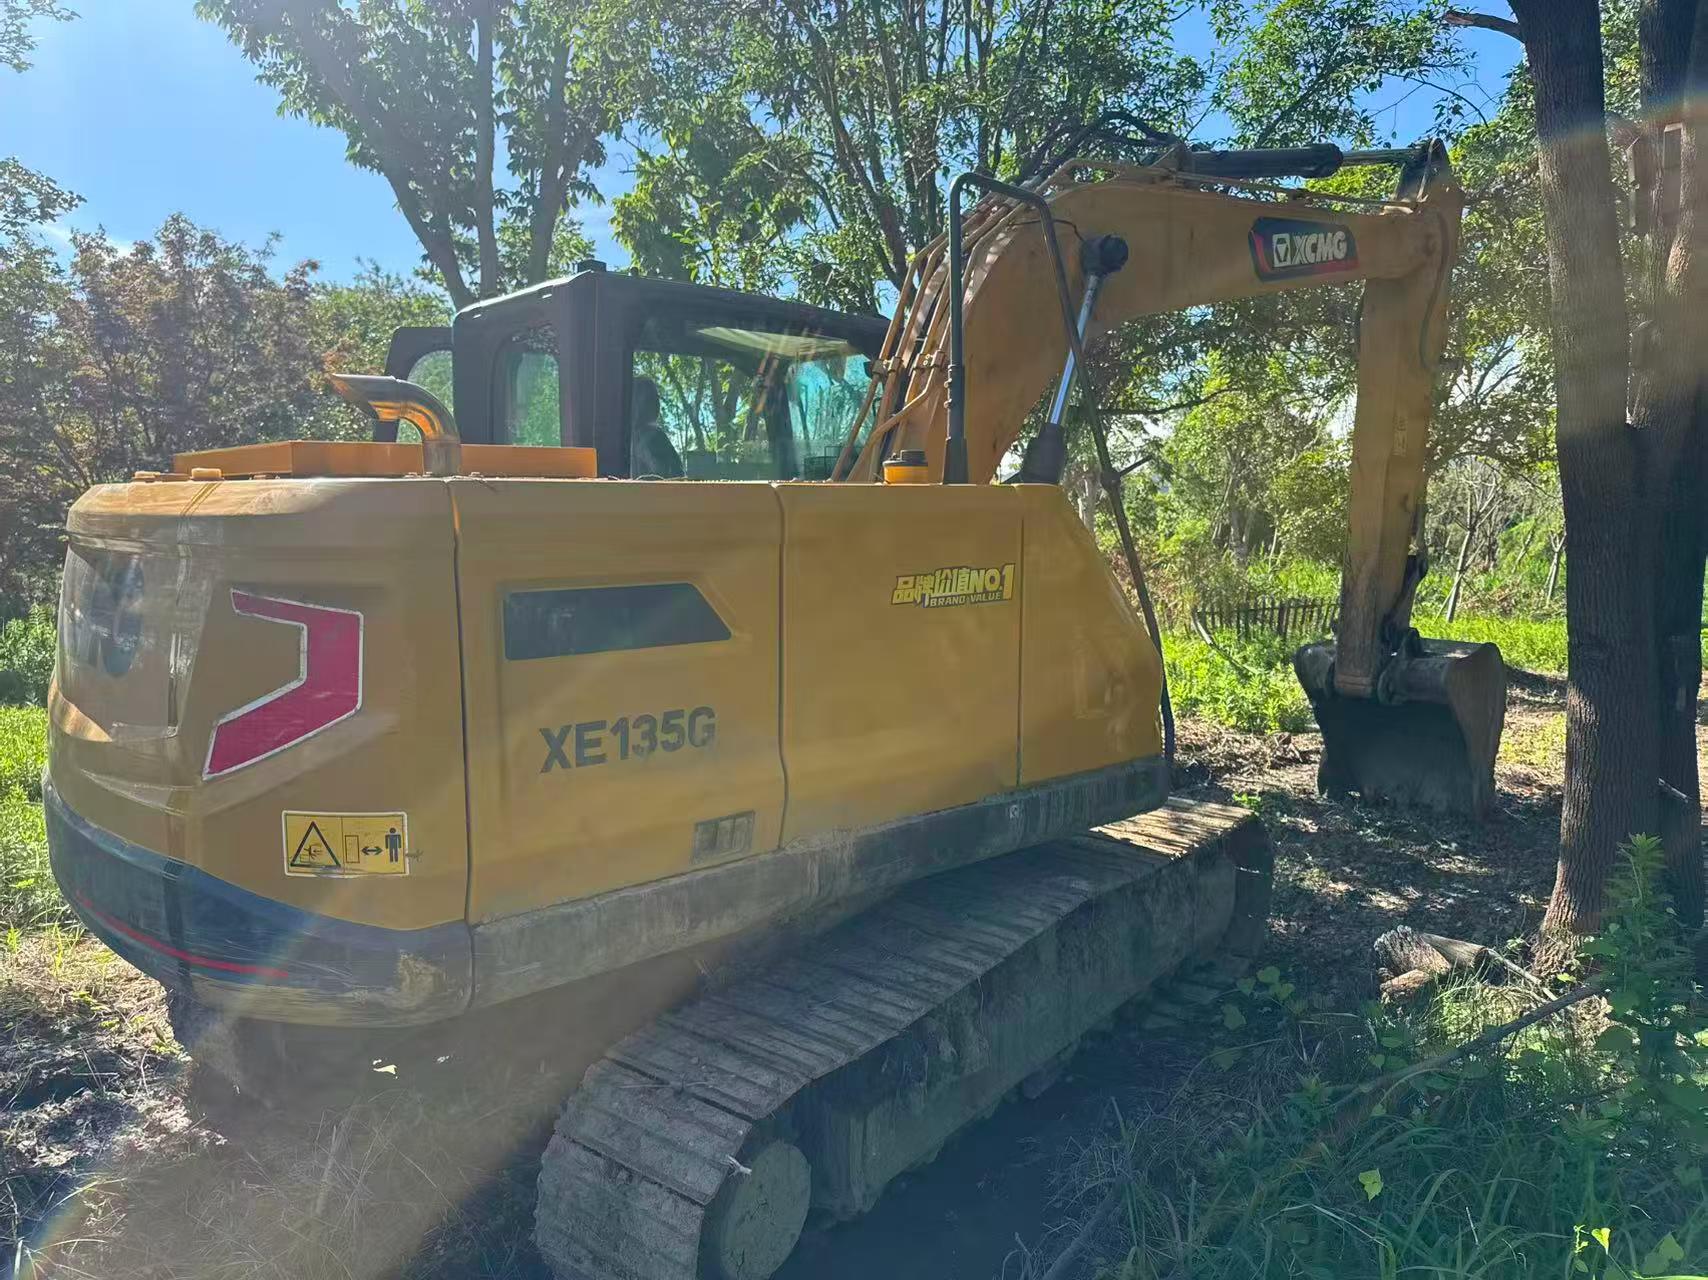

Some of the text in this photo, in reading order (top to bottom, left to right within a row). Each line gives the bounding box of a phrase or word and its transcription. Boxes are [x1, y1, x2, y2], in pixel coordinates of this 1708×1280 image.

[1291, 231, 1348, 265] XCMG
[930, 591, 1001, 607] BRAND VALUE
[539, 706, 716, 774] XE135G
